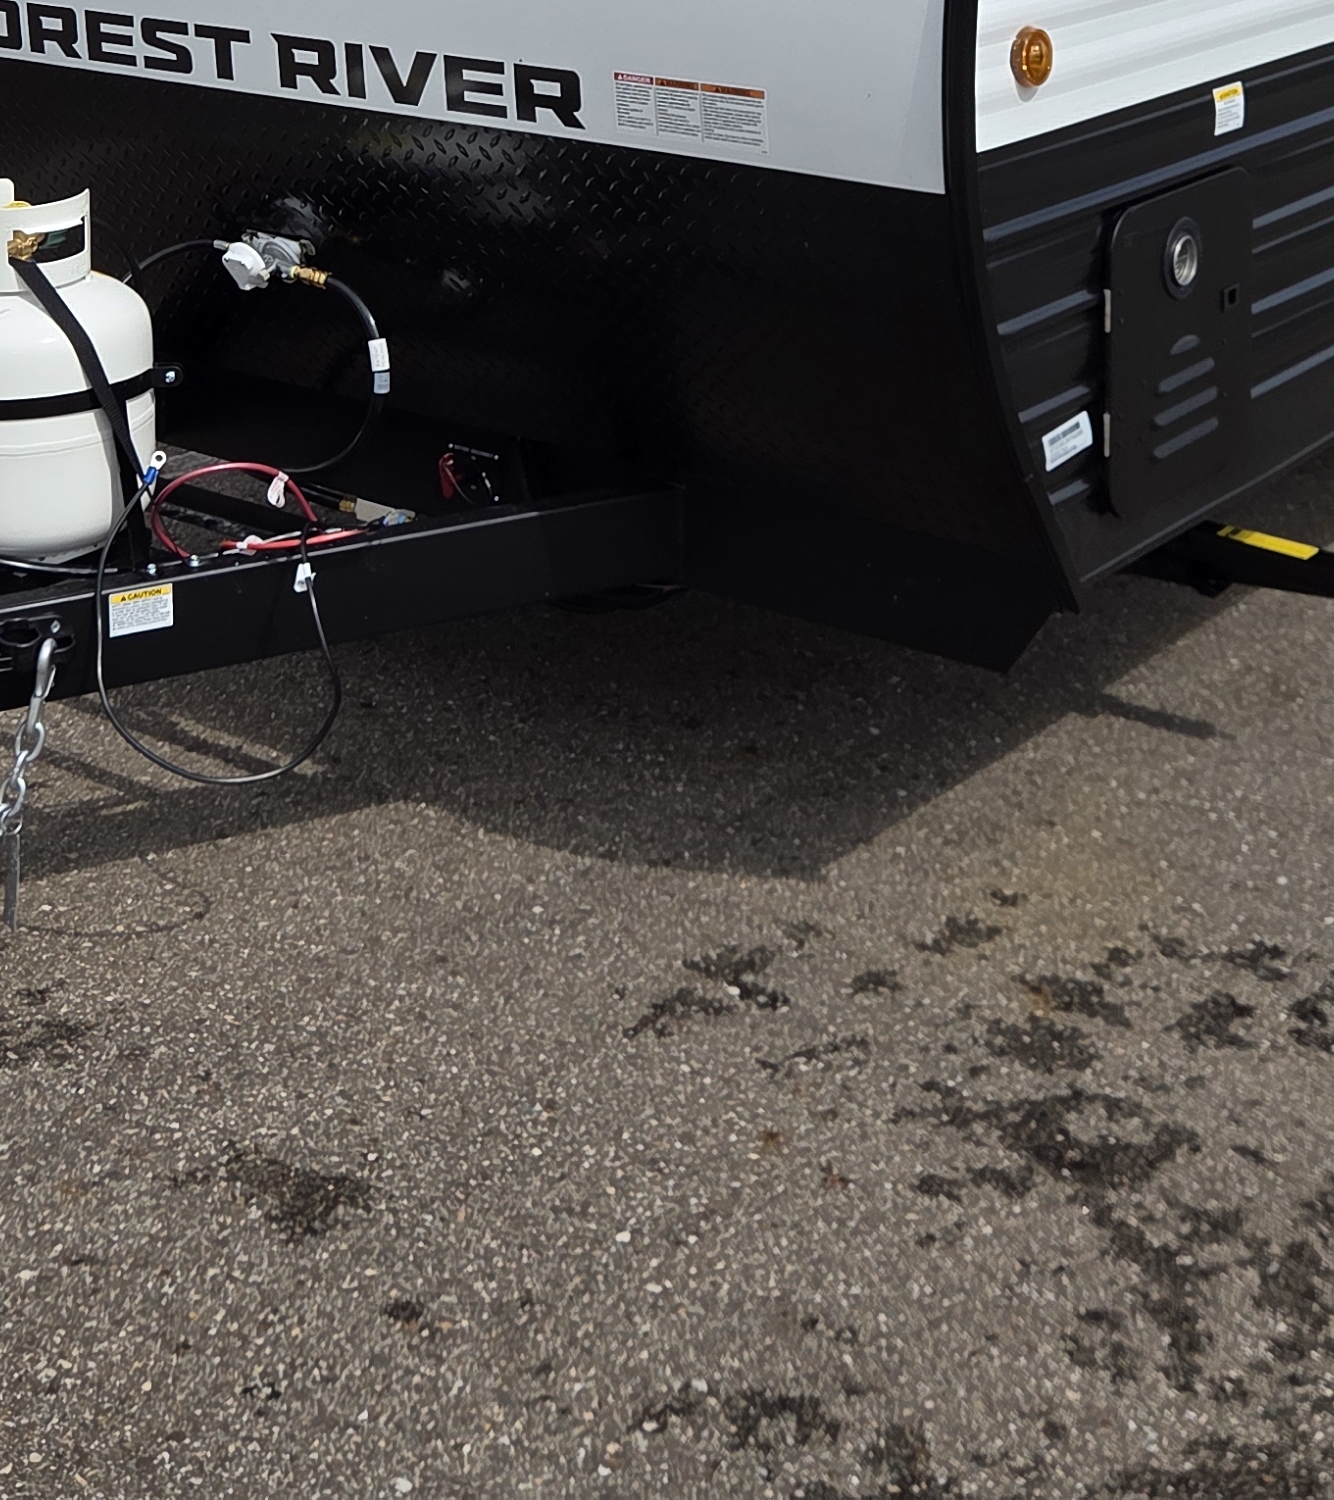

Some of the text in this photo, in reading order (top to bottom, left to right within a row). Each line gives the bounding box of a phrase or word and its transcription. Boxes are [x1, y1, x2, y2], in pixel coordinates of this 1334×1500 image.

[270, 32, 587, 130] RIVER
[623, 74, 651, 84] DANGER
[127, 588, 162, 600] CAUTION
